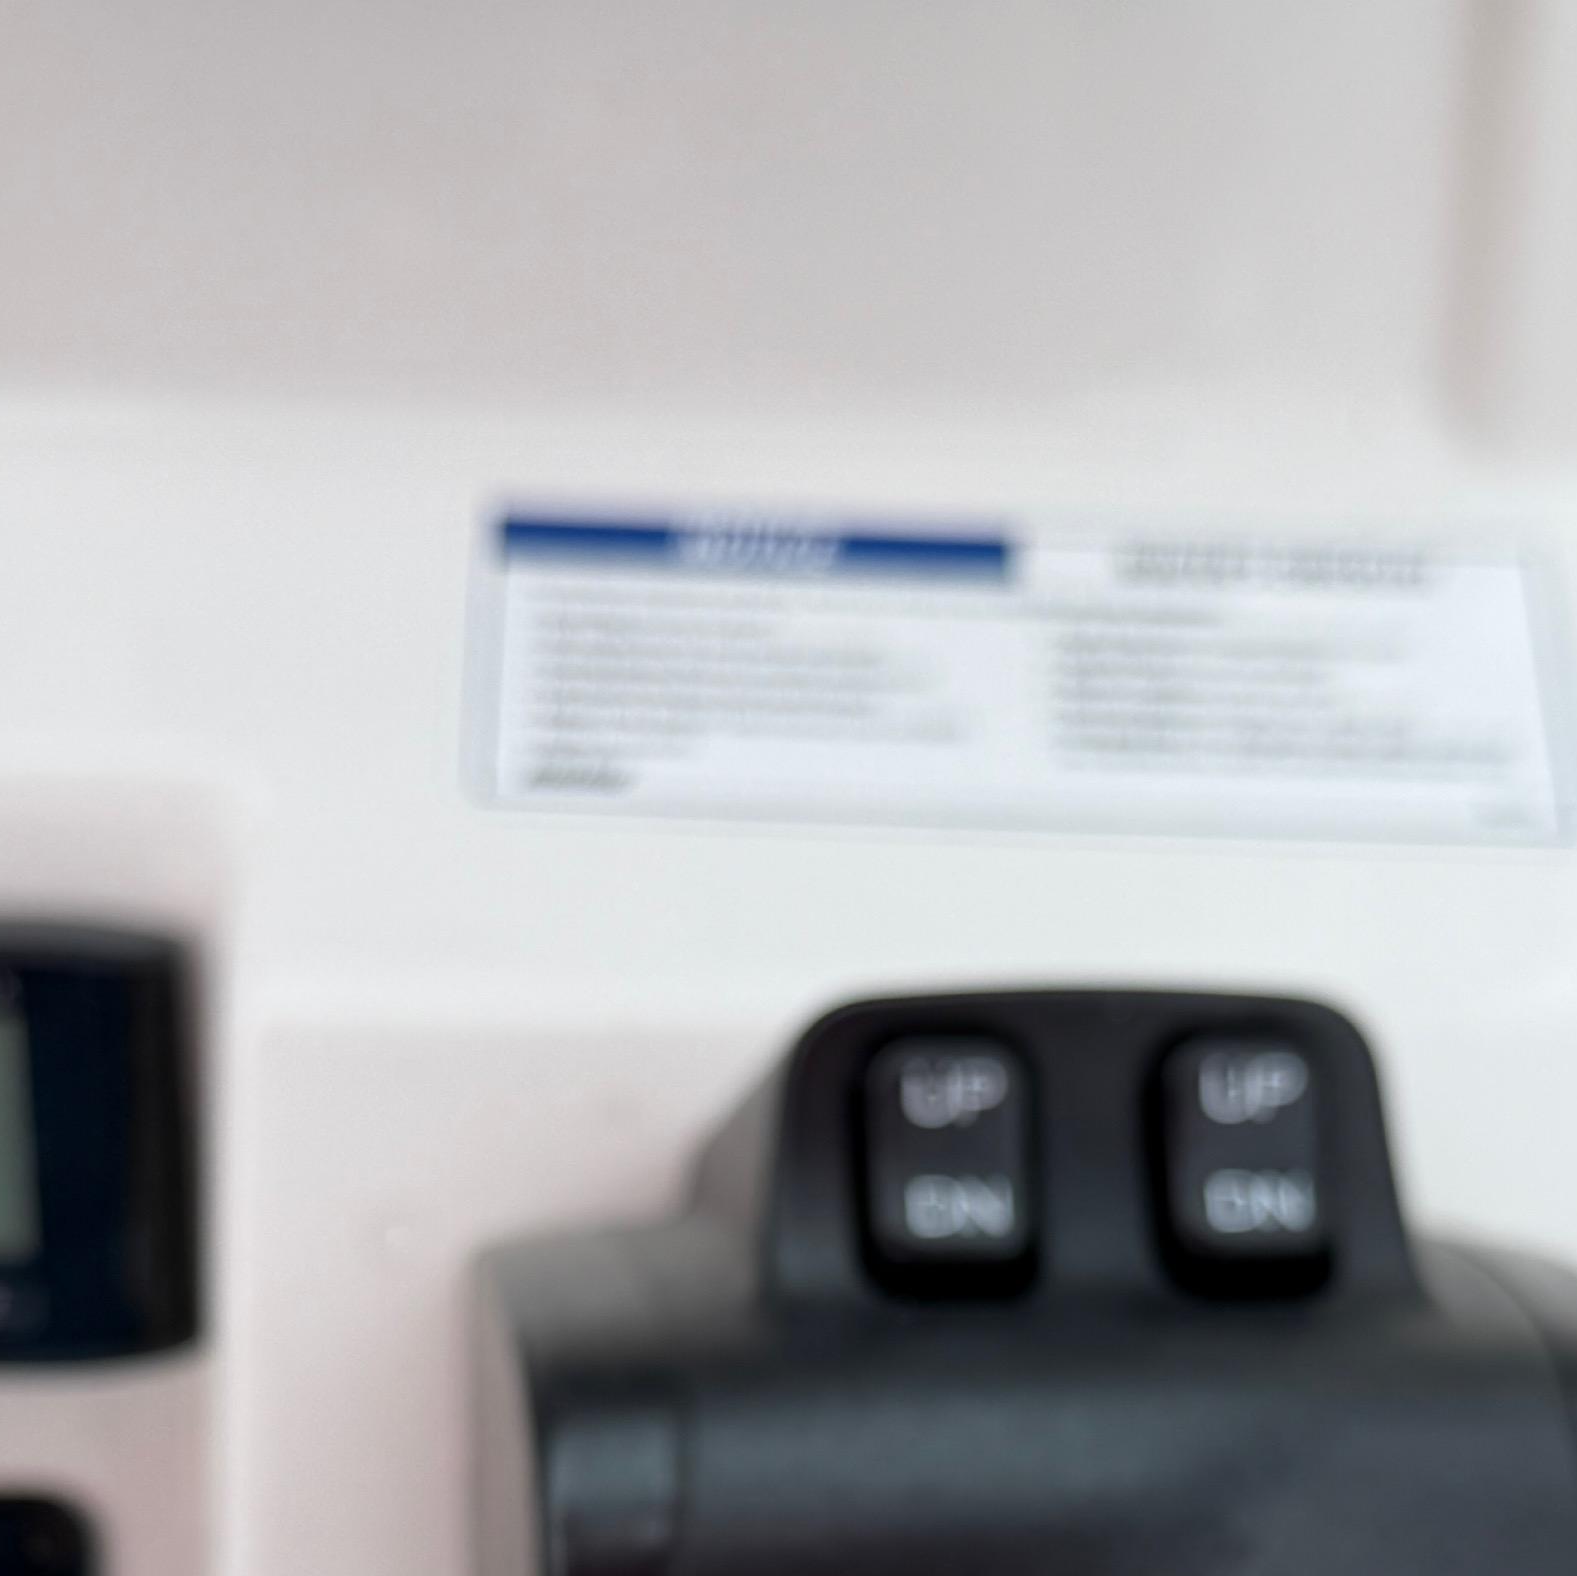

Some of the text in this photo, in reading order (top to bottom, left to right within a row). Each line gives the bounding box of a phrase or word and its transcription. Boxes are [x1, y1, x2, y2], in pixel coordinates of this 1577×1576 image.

[901, 1056, 1007, 1127] UP
[1199, 1052, 1308, 1123] UP
[904, 1174, 1013, 1237] DN
[1204, 1168, 1315, 1232] DN
